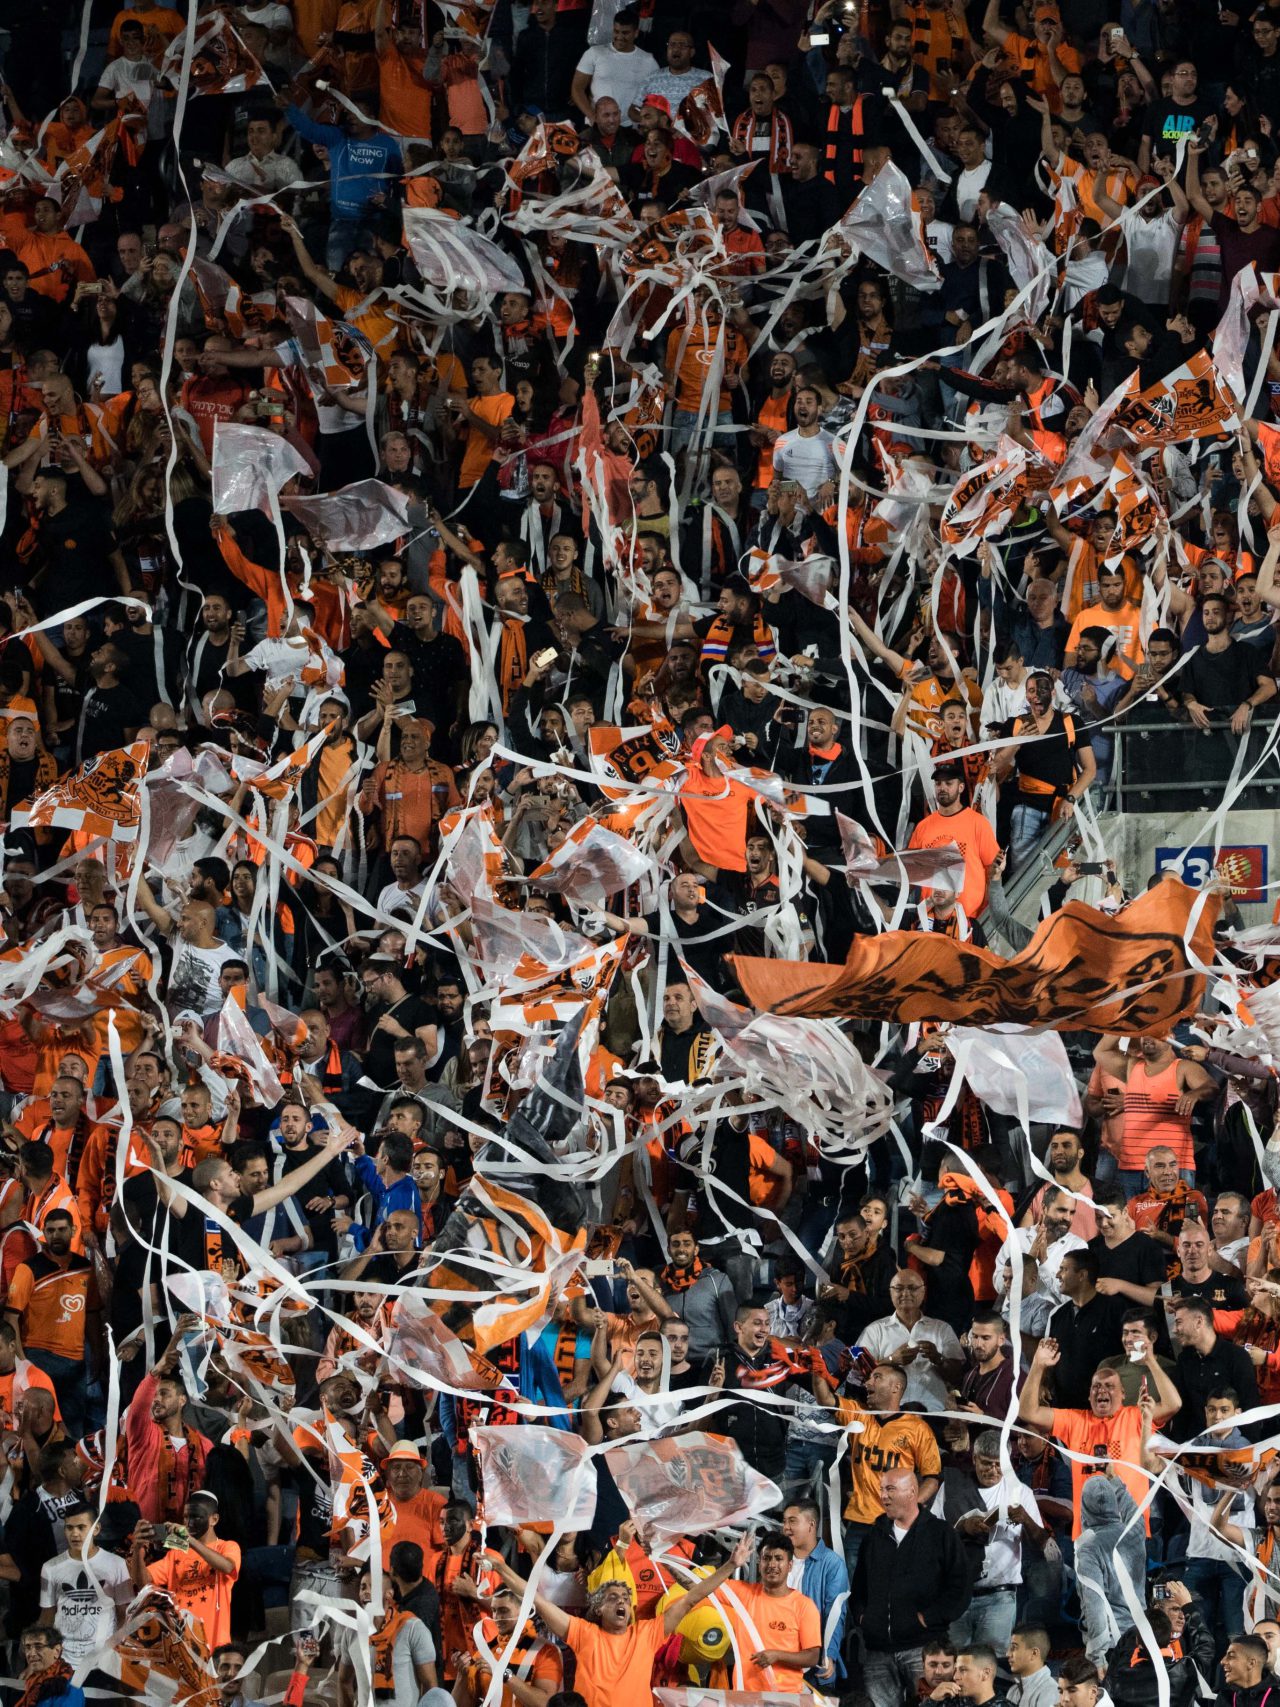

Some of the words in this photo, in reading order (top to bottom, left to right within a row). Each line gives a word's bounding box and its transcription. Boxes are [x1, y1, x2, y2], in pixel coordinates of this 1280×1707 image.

[1163, 114, 1195, 132] AIR
[613, 738, 650, 762] GATE
[61, 1604, 102, 1617] adidas
